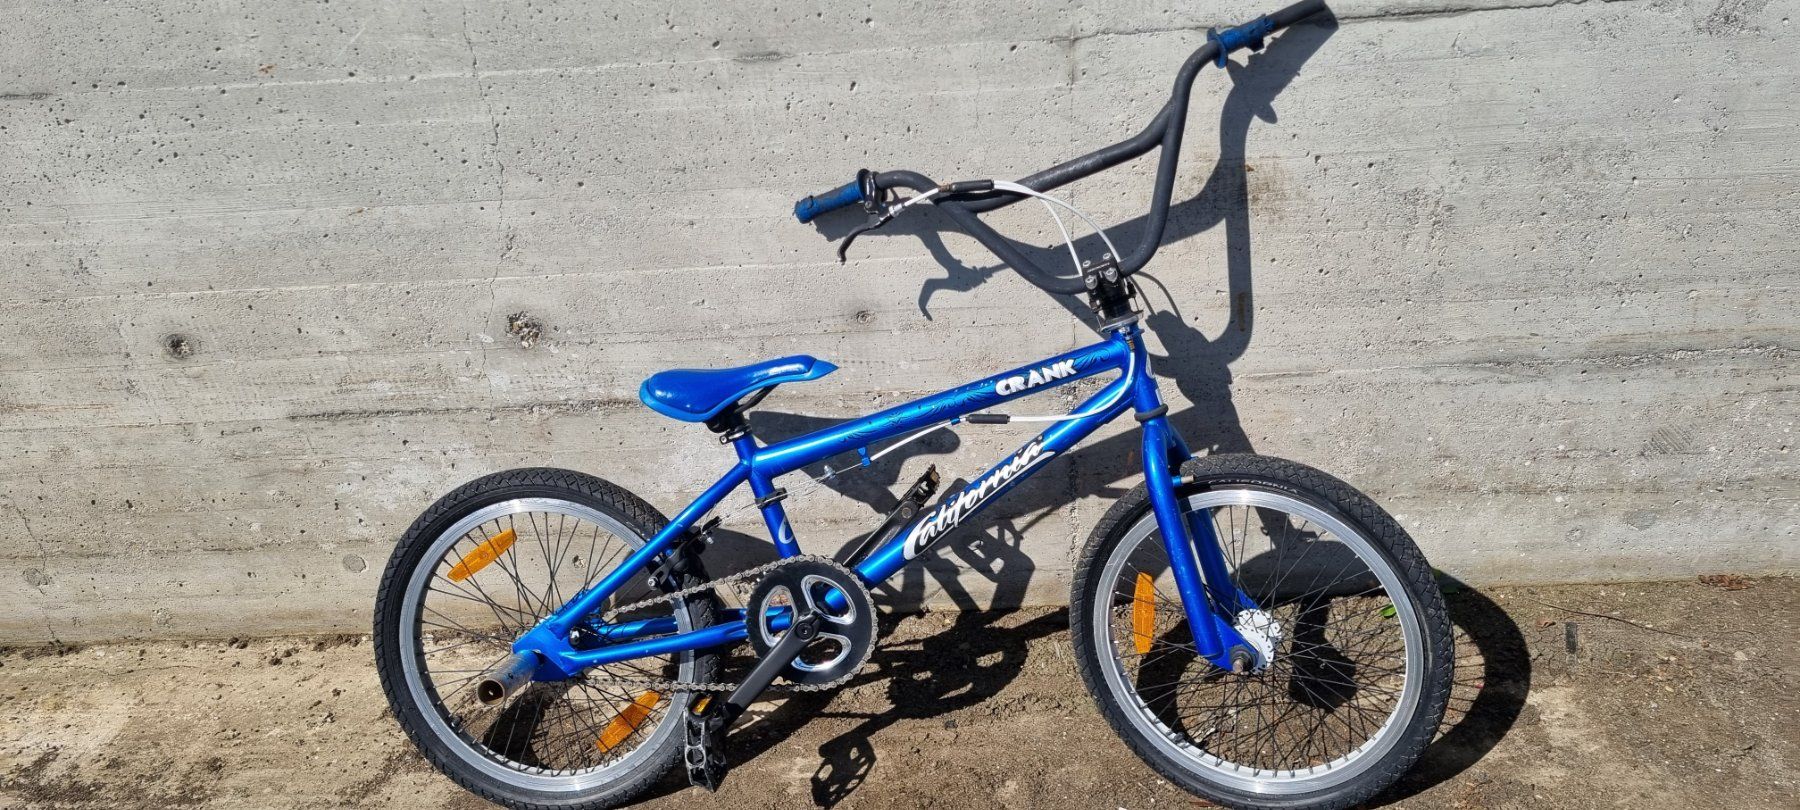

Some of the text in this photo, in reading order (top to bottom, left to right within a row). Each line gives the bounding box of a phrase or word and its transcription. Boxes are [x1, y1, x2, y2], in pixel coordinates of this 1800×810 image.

[995, 359, 1077, 396] CRANK
[903, 441, 1044, 560] California
[1208, 479, 1298, 495] CALIFORNIA
